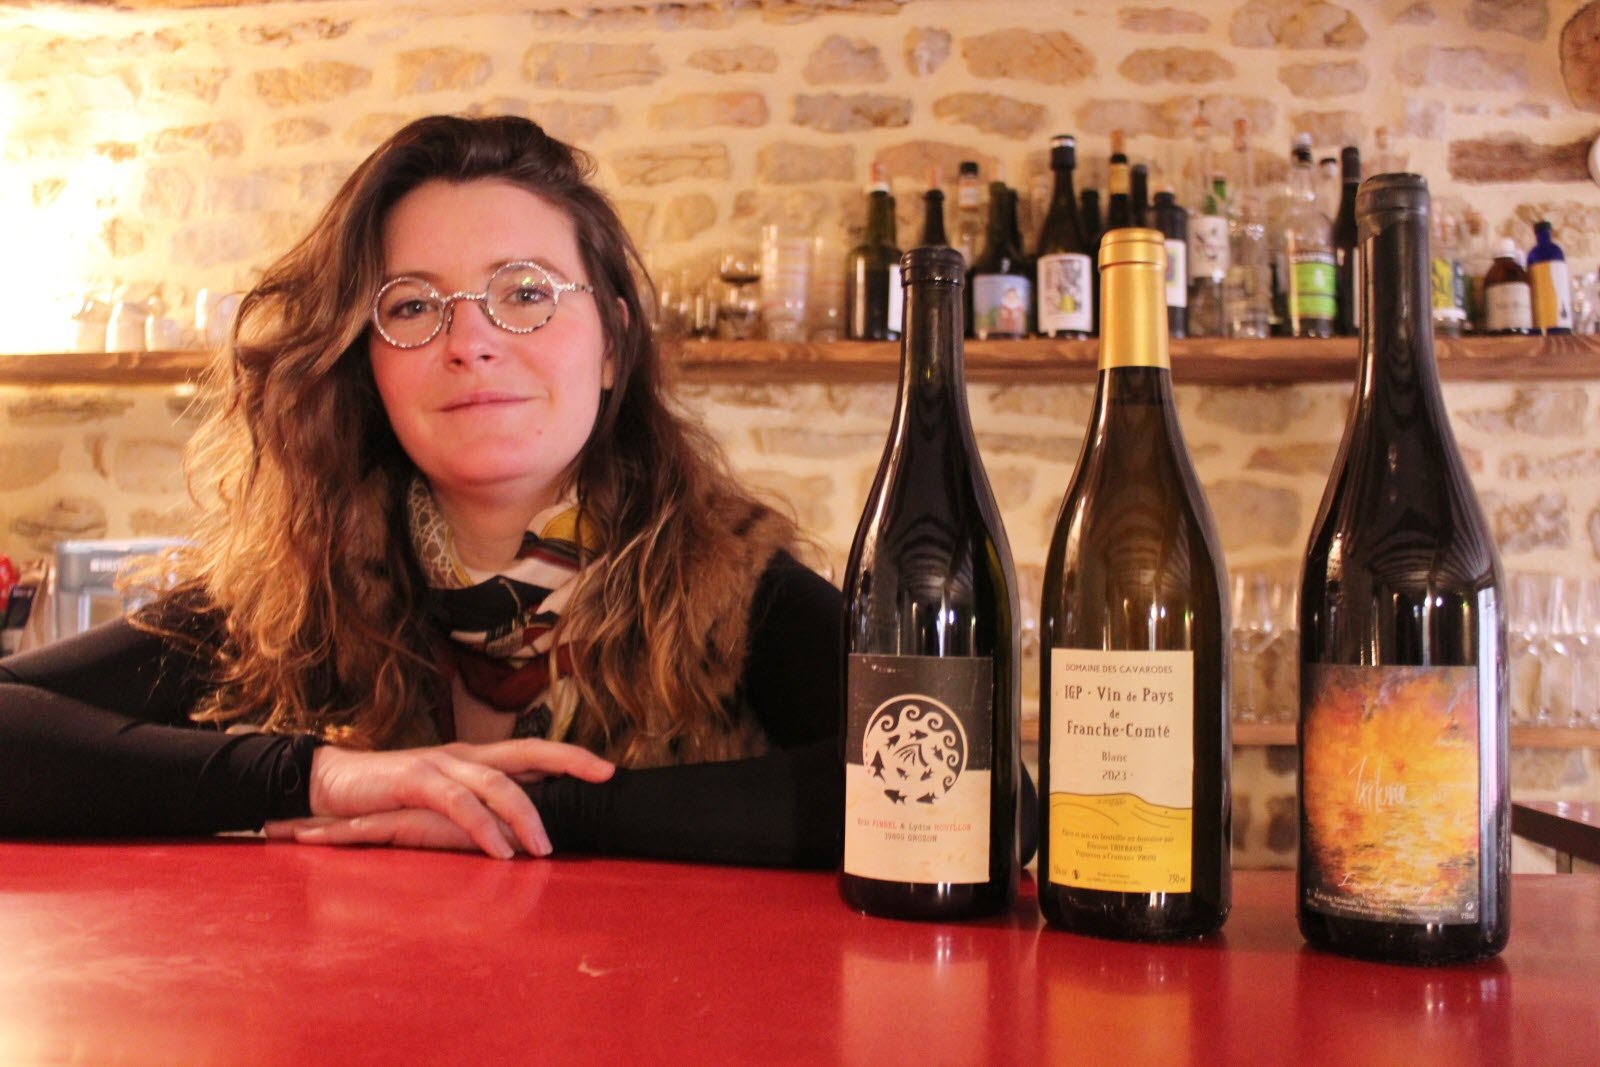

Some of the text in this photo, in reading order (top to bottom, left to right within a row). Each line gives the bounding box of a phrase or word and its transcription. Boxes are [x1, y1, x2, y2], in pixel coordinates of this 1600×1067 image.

[1065, 663, 1173, 674] DOMAINE DES CAVARODES
[1065, 684, 1174, 704] IGP Vin de Pays
[1109, 708, 1120, 719] de
[1067, 720, 1170, 738] Franche-Comté
[1101, 751, 1127, 763] Blanc
[1101, 770, 1127, 781] 2023
